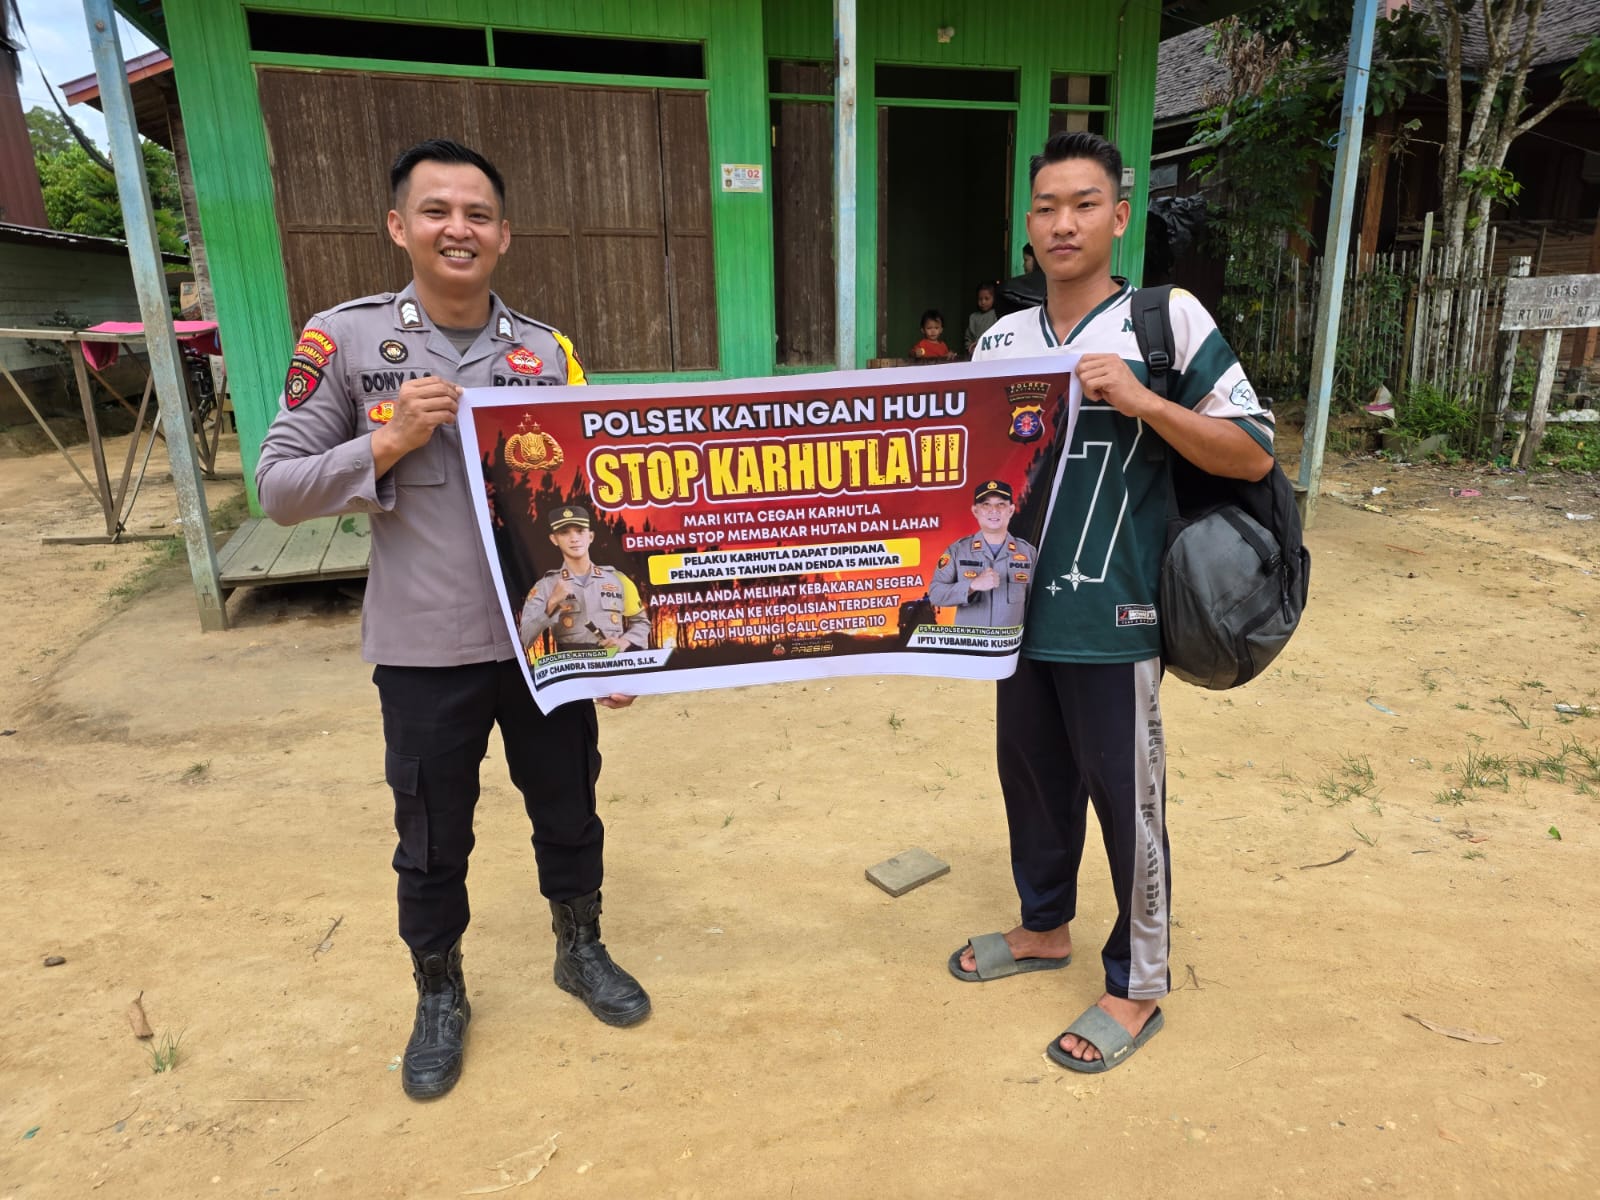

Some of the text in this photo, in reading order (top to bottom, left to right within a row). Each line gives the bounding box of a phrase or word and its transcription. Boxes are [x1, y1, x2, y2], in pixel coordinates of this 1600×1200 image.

[747, 169, 760, 179] 02
[1518, 309, 1532, 321] RT
[1577, 306, 1590, 317] RT
[981, 331, 1015, 351] NYC
[361, 371, 404, 392] DONY
[583, 391, 966, 437] POLSEK KATINGAN HULU
[594, 433, 960, 504] STOP KARHUTLA !!!
[684, 503, 881, 527] MARI KITA CEGAH KARHUTLA
[626, 516, 940, 549] DENGAN STOP MEMBAKAR HUTAN DAN LAHAN
[684, 543, 885, 566] PELAKU KARHUTLA DAPAT DIPIDANA
[670, 555, 899, 580] PENJARA 15 TAHUN DAN DENDA 15 MILYAR
[649, 575, 923, 607] APABILA ANDA MELIHAT KEBAKARAN SEGERA
[676, 595, 900, 624] LAPORKAN KE KEPOLISIAN TERDEKAT
[694, 615, 886, 641] ATAU HUBUNGI CALL CENTER 110
[966, 627, 1000, 635] KATINGAN
[917, 636, 937, 645] IPTU
[939, 636, 989, 648] YUBAMBANG
[549, 662, 586, 675] CHANDRA
[587, 658, 636, 670] ISMAWANTO,
[637, 656, 658, 666] S.I.K.
[572, 649, 608, 659] KATINGAN
